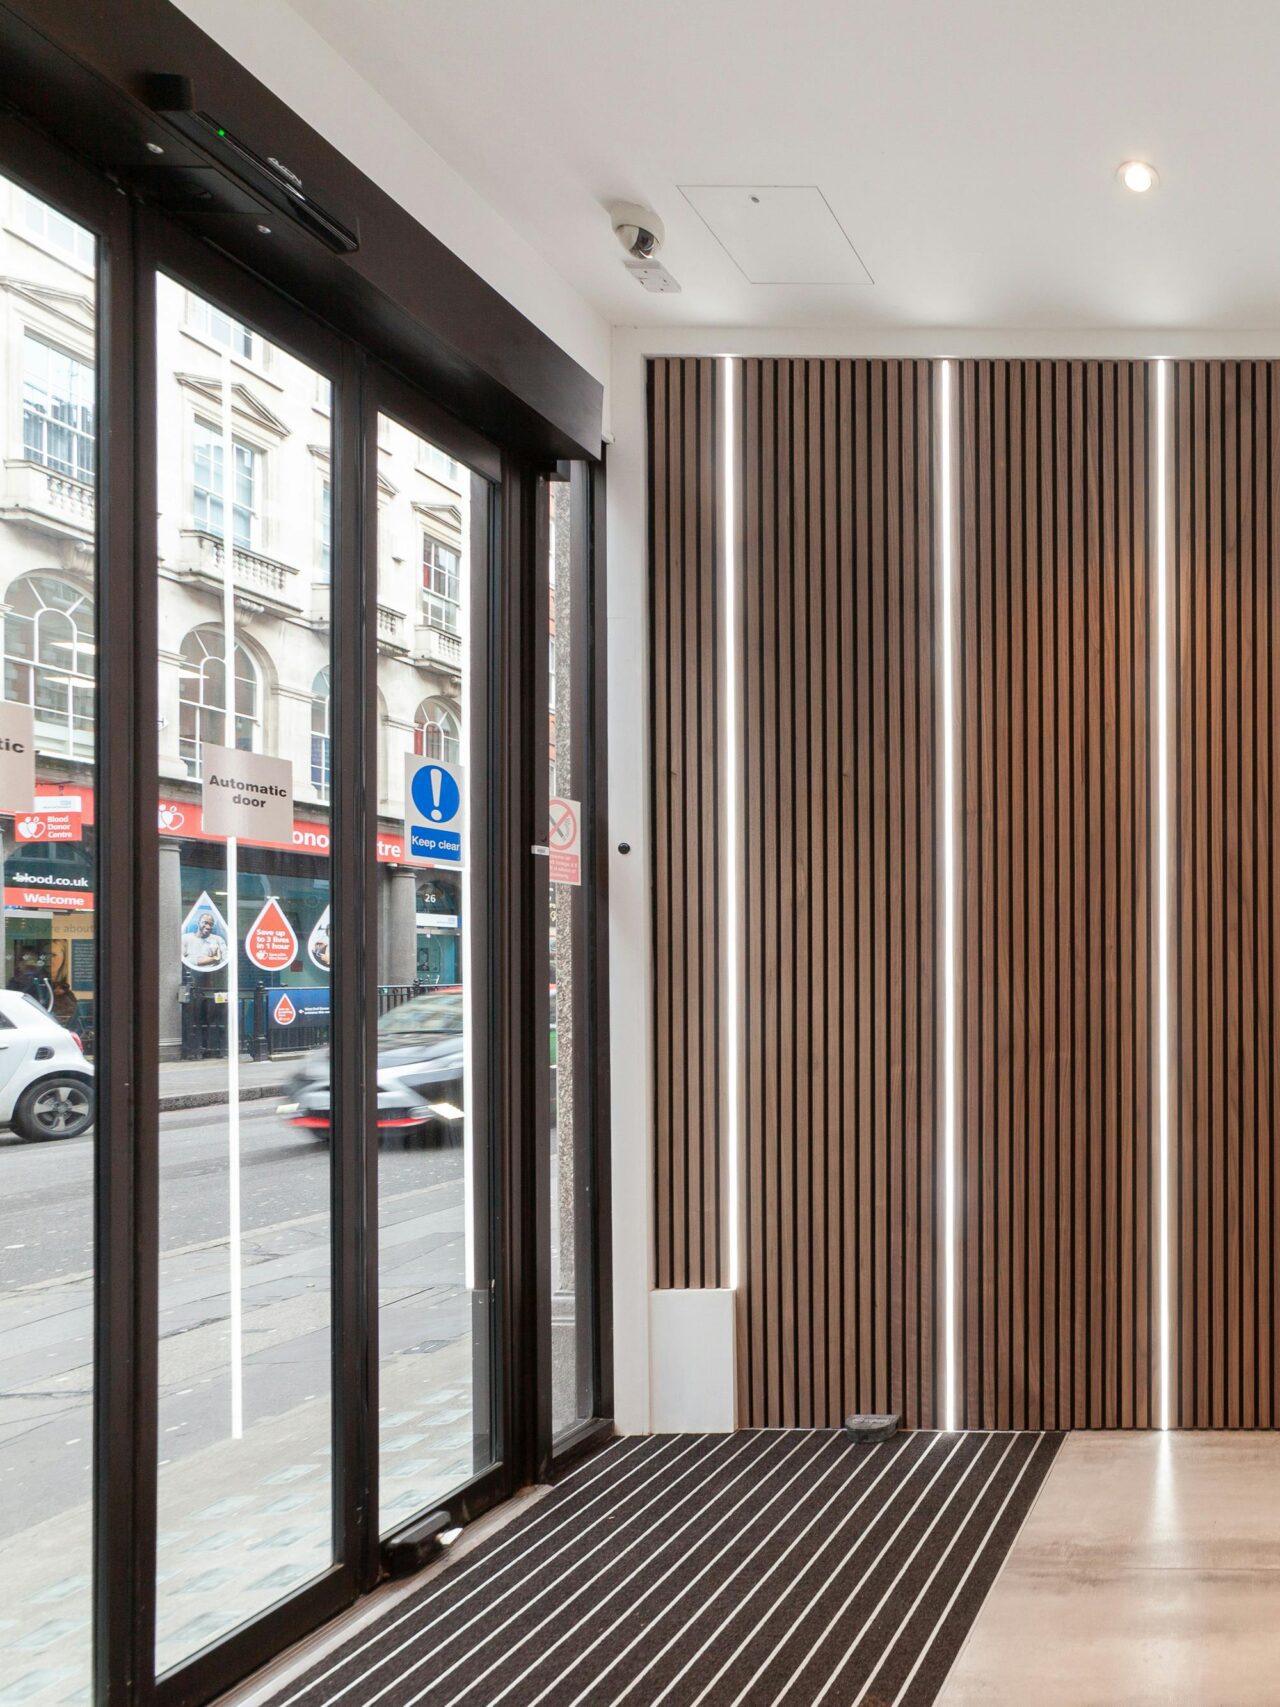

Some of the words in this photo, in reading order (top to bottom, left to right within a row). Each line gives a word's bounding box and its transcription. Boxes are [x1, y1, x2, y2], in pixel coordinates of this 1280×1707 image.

[209, 775, 287, 797] Automatic
[232, 794, 267, 808] door
[47, 815, 70, 823] Blood
[48, 831, 73, 839] Centre
[412, 835, 436, 850] Keep
[438, 839, 461, 851] clear
[23, 892, 85, 906] Welcome
[424, 893, 437, 903] 26
[256, 928, 274, 936] Save
[275, 930, 286, 938] up
